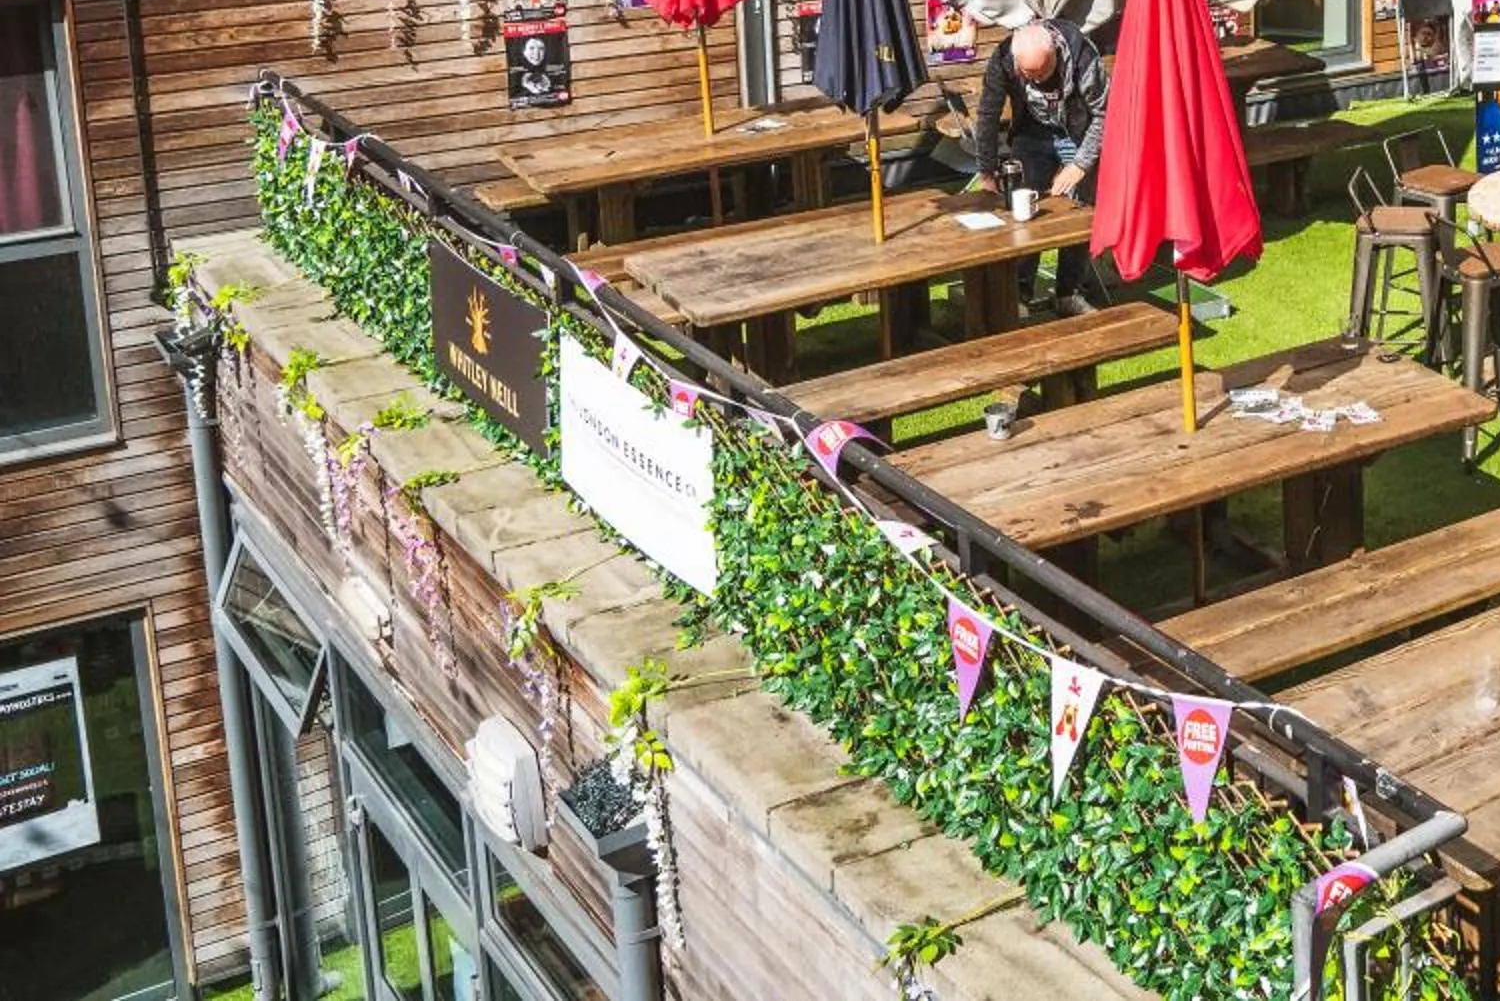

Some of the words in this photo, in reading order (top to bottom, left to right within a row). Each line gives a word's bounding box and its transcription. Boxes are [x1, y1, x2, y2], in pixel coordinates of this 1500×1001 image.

[579, 407, 620, 449] ONDON
[622, 440, 682, 494] ESSENCE
[1183, 720, 1217, 743] FREE
